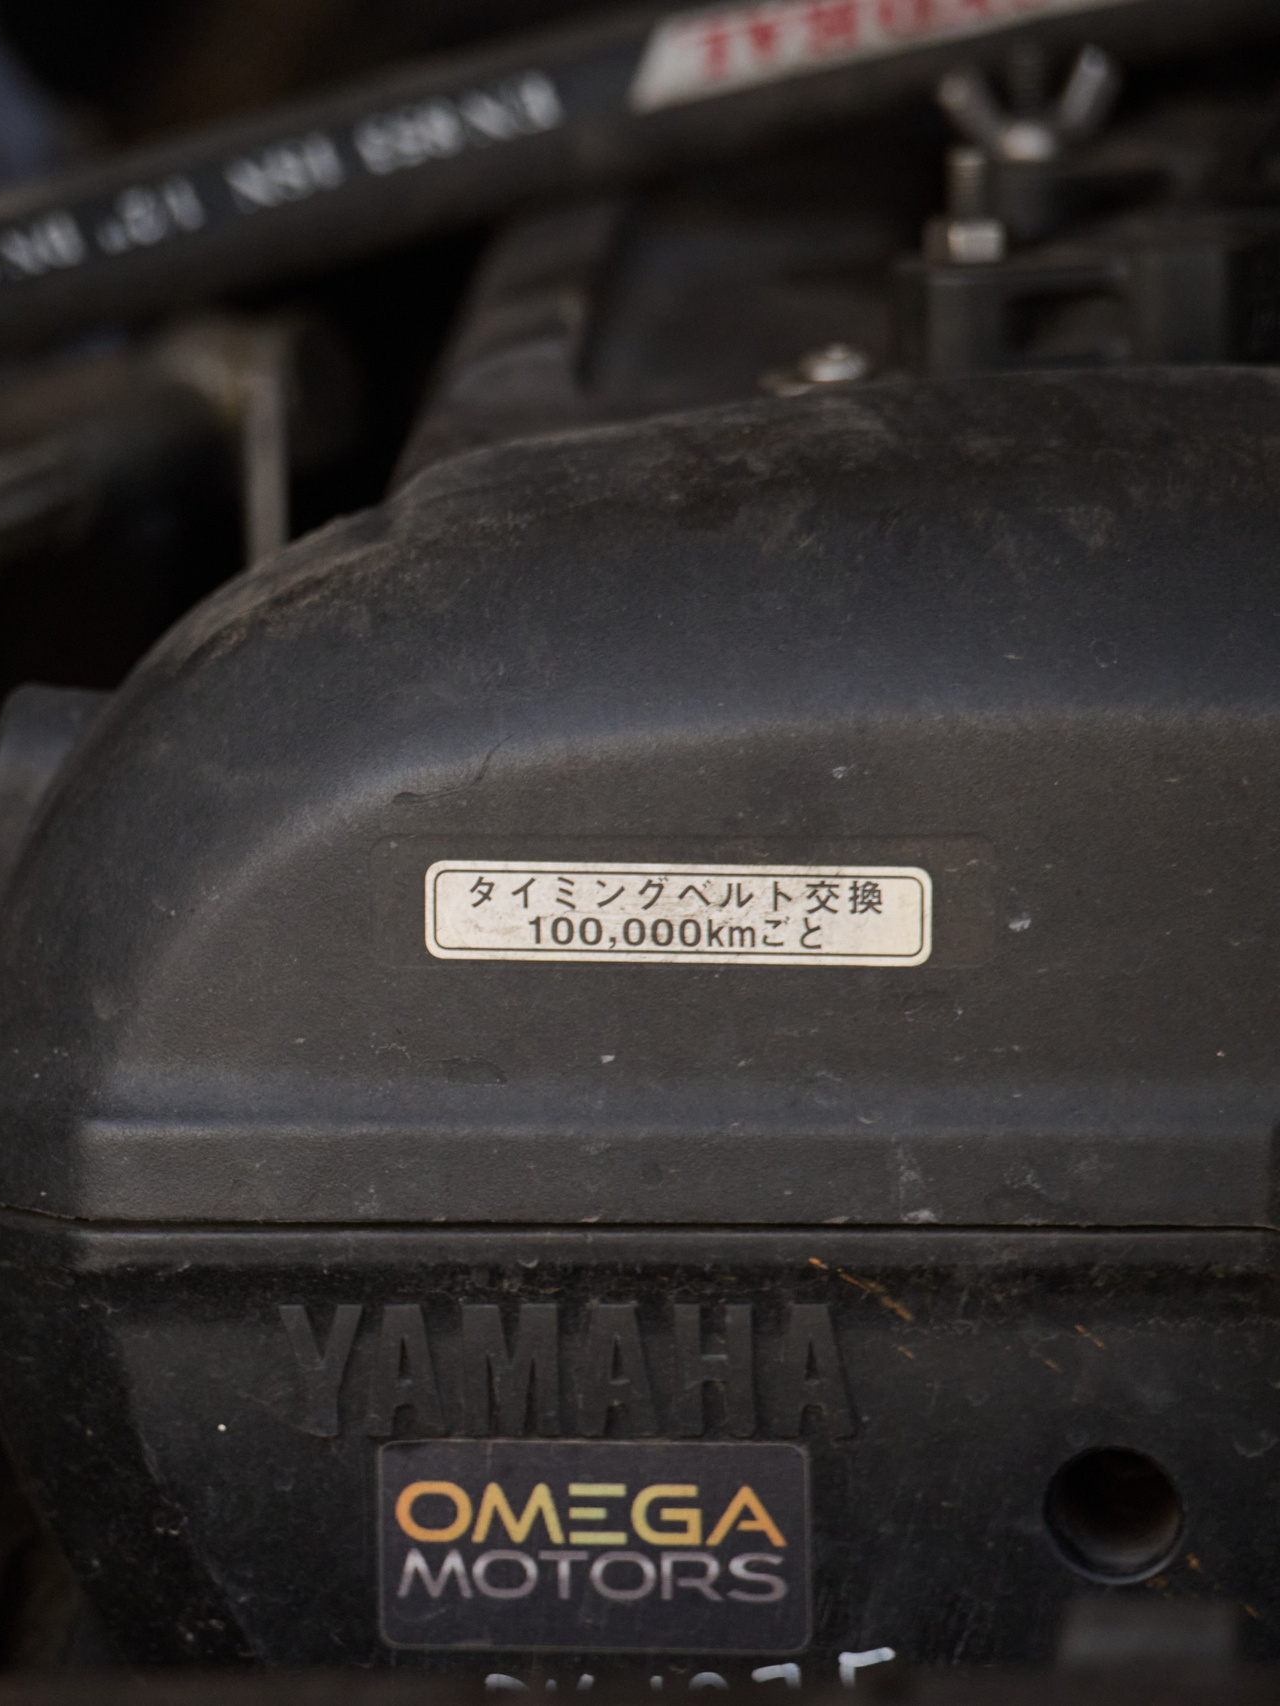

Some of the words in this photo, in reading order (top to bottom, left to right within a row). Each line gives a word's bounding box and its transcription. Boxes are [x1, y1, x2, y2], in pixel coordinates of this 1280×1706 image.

[469, 876, 883, 915] タイミングベルト交換
[528, 916, 823, 950] 100,000kmごと
[278, 1302, 858, 1441] YAMAHA
[395, 1480, 787, 1547] OMEGA
[396, 1549, 788, 1602] MOTORS
